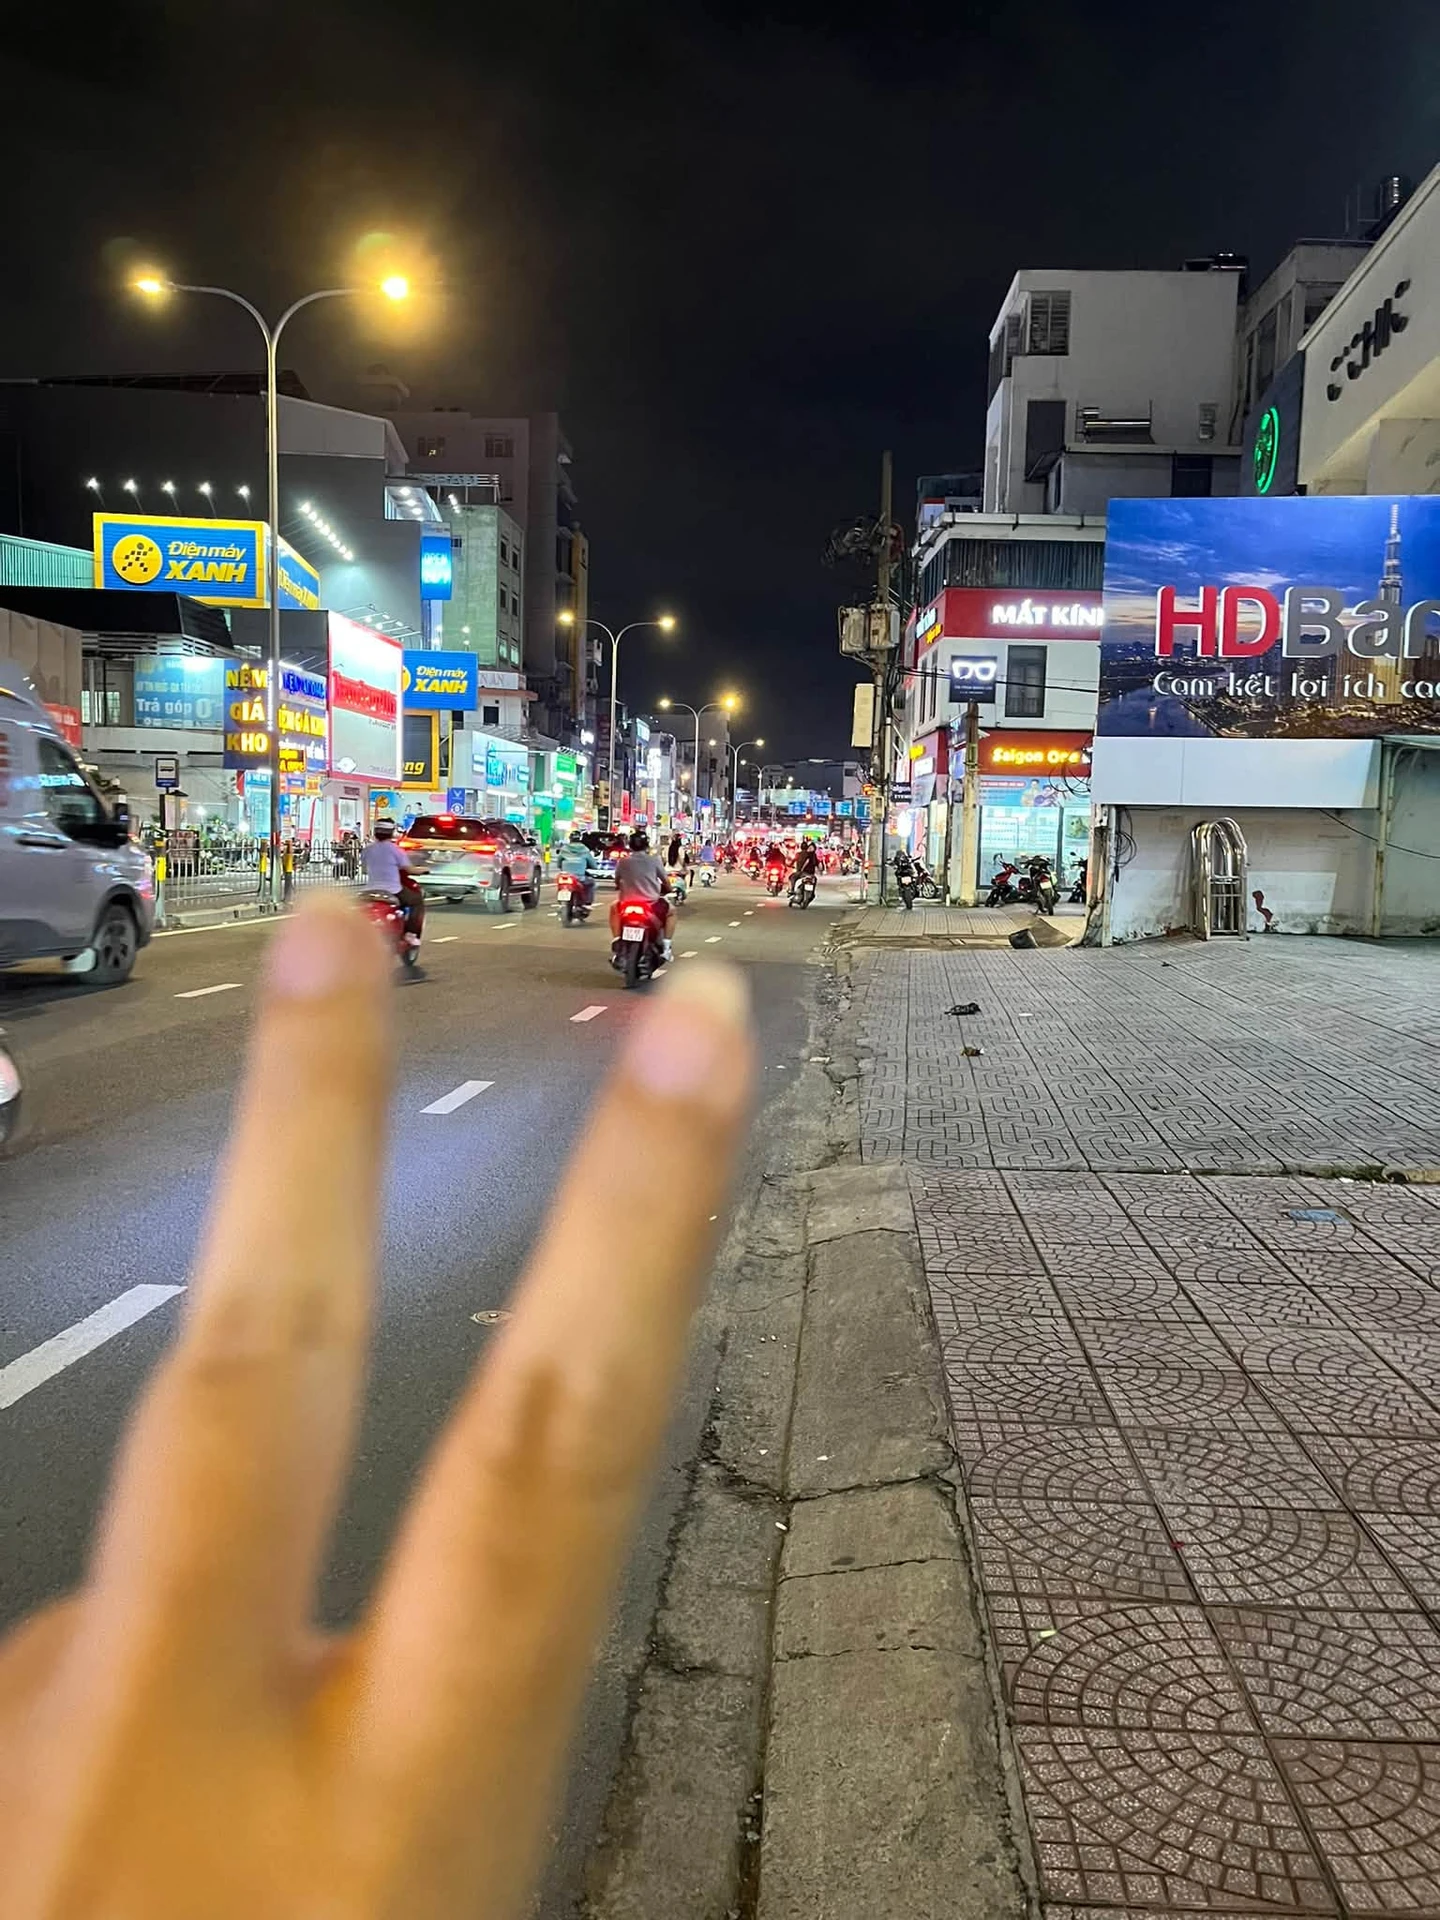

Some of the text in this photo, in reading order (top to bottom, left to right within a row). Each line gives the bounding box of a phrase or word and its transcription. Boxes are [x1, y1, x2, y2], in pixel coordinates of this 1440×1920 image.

[167, 541, 247, 562] Điện máy
[164, 560, 248, 583] XANH
[415, 665, 443, 679] Điện
[442, 667, 468, 680] máy
[413, 678, 468, 694] XANH
[1153, 671, 1216, 696] Cam
[1228, 672, 1276, 697] kết
[1291, 672, 1328, 701] lợi
[1343, 673, 1385, 698] ích
[136, 697, 160, 713] Trả
[164, 700, 192, 716] góp
[230, 696, 265, 723] GIÁ
[226, 732, 269, 753] KHO
[992, 747, 1044, 766] Saigon
